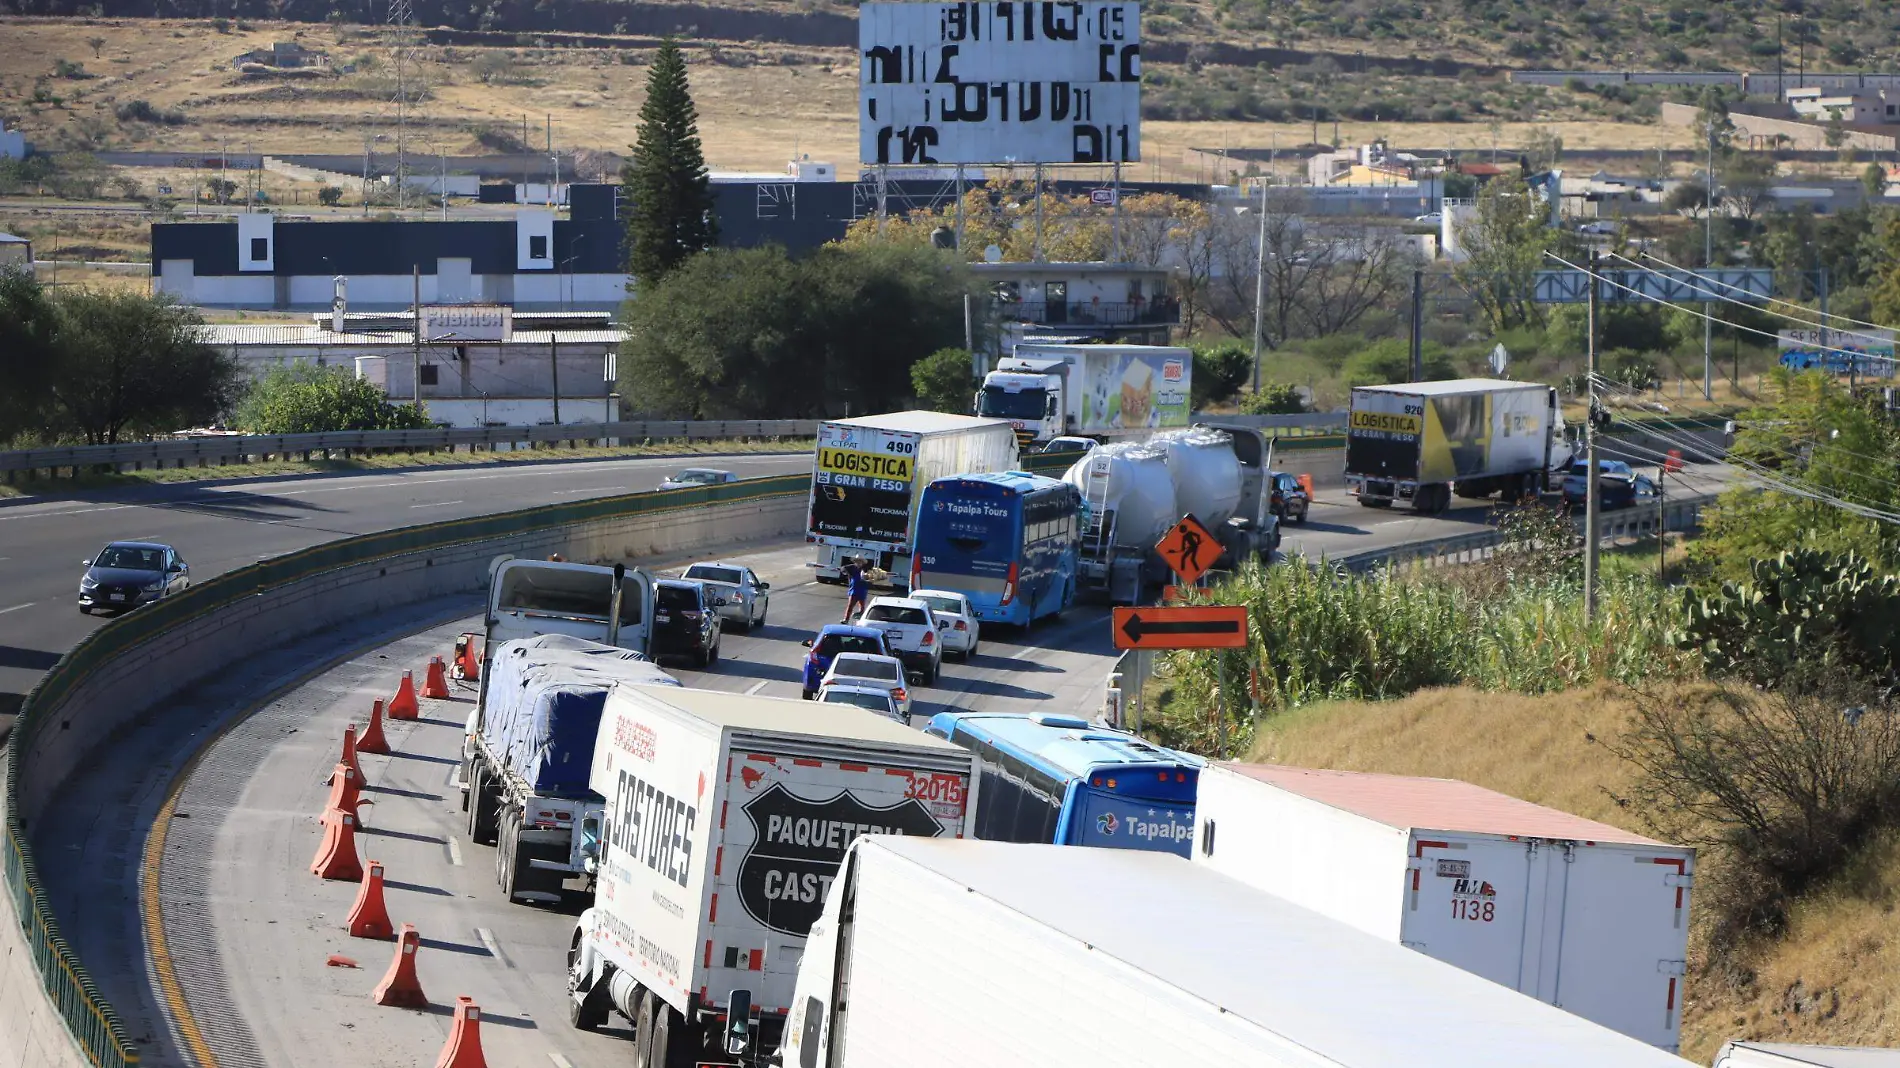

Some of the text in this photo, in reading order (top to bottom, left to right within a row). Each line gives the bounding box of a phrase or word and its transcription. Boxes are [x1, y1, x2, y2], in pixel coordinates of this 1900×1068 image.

[1405, 404, 1422, 415] 920
[1354, 412, 1415, 431] LOGISTICA
[886, 441, 913, 454] 490
[823, 450, 907, 477] LOGISTICA
[834, 474, 903, 491] GRAN PESO
[870, 506, 908, 516] TRUCKMAN
[947, 503, 1008, 517] Tapalpa Tours
[922, 556, 936, 564] 350
[903, 775, 962, 803] 32015
[612, 769, 696, 888] CASTORES
[1126, 816, 1194, 843] Tapalpa
[764, 870, 836, 904] CAST
[1452, 899, 1494, 922] 1138
